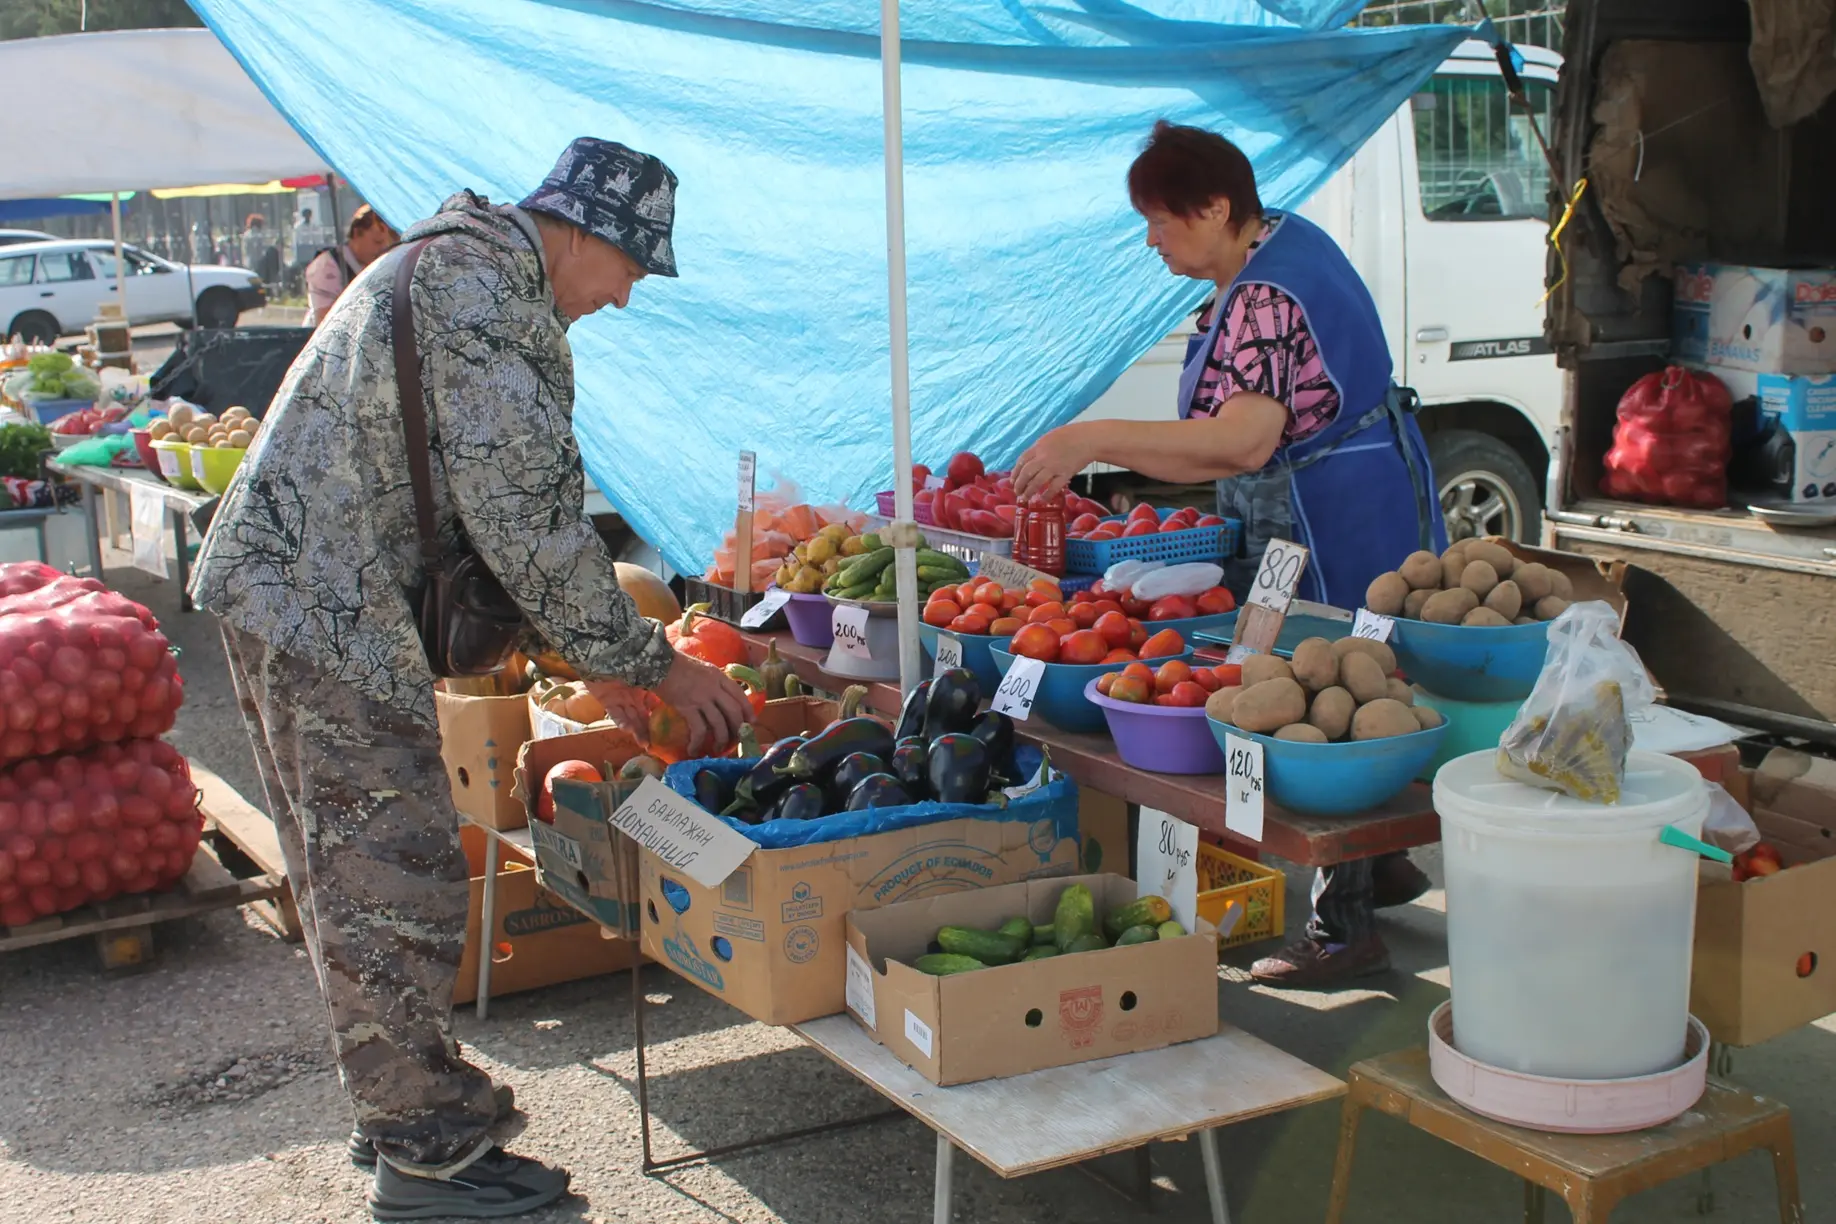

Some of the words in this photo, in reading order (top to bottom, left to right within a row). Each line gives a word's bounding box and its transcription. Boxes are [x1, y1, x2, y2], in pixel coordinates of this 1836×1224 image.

[1474, 340, 1531, 357] ATLAS
[1711, 342, 1760, 363] BANANAS
[1258, 548, 1300, 591] 80
[835, 622, 857, 639] 200
[938, 648, 957, 667] 200
[999, 675, 1031, 698] 200
[1229, 748, 1254, 779] 120
[647, 798, 715, 848] БАКЛАЖАН
[609, 805, 699, 869] ДОМАШНИЙ
[1158, 820, 1176, 856] 80
[874, 861, 923, 902] PRODUCT
[926, 857, 941, 869] OF
[943, 857, 995, 881] ECUADOR
[509, 909, 579, 932] SABROST
